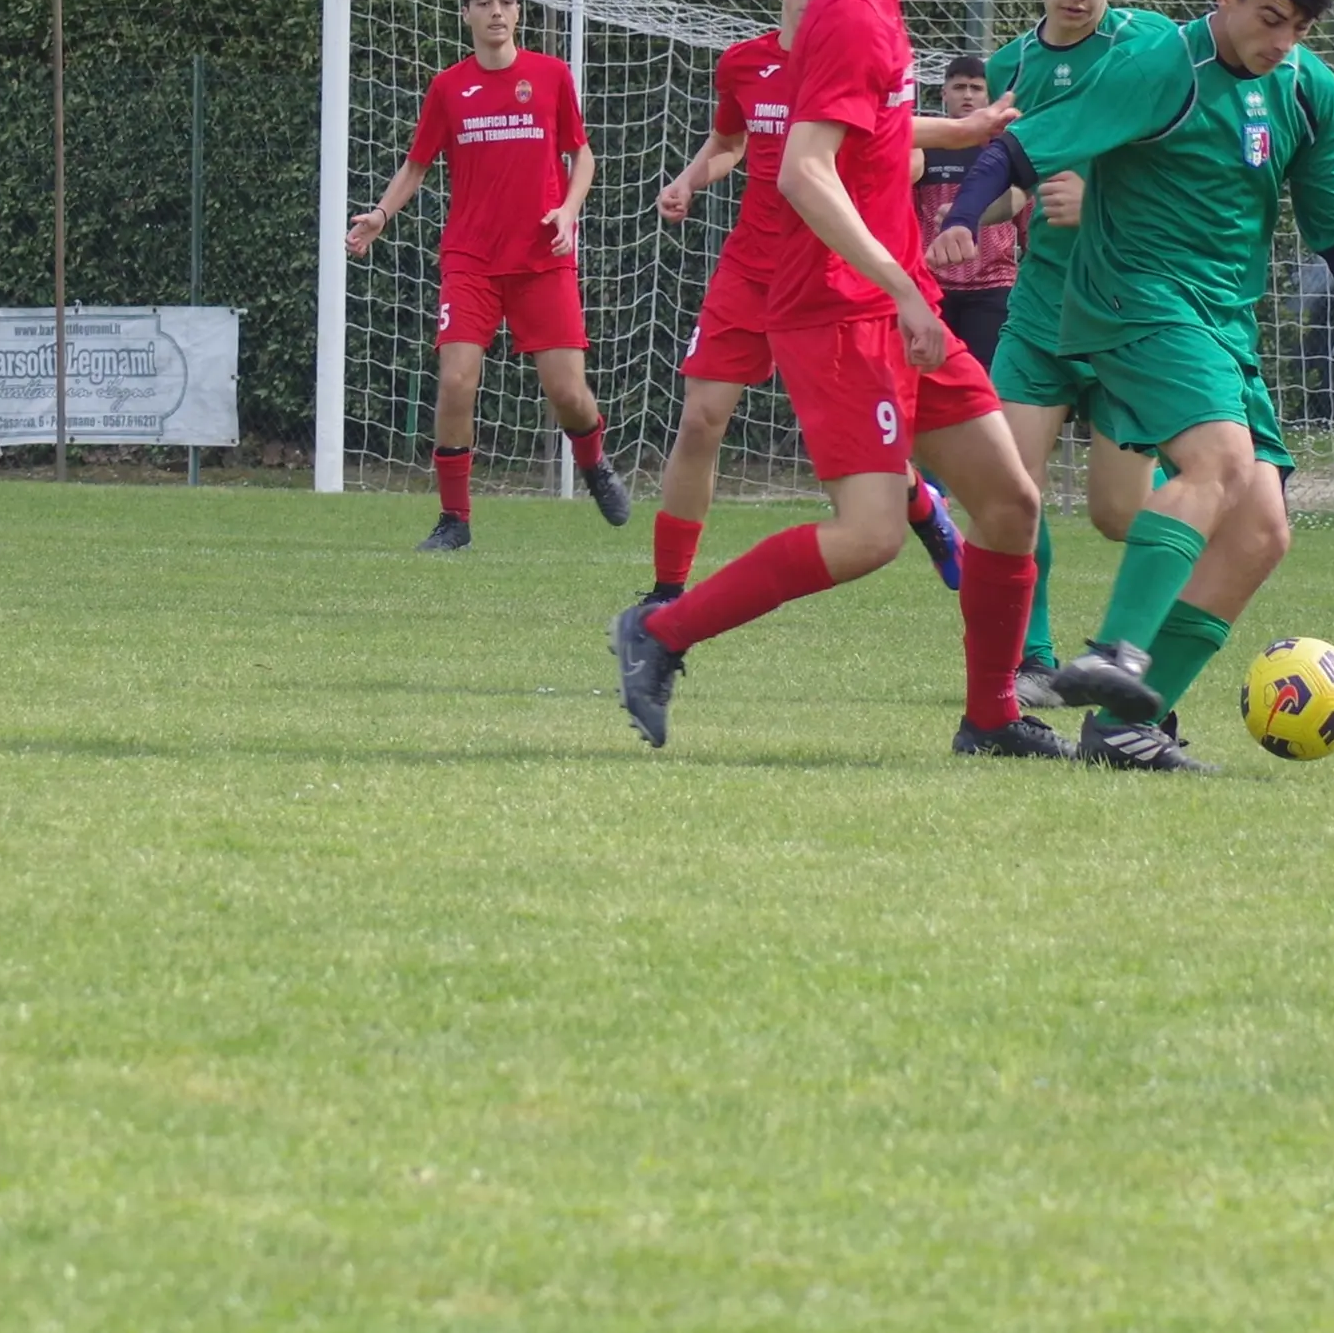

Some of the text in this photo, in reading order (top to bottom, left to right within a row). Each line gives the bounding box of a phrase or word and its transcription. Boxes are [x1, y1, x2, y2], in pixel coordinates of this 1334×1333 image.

[462, 115, 507, 130] TOMAIFICIO
[439, 303, 450, 331] 5
[65, 341, 157, 385] Legnami
[877, 401, 897, 445] 9
